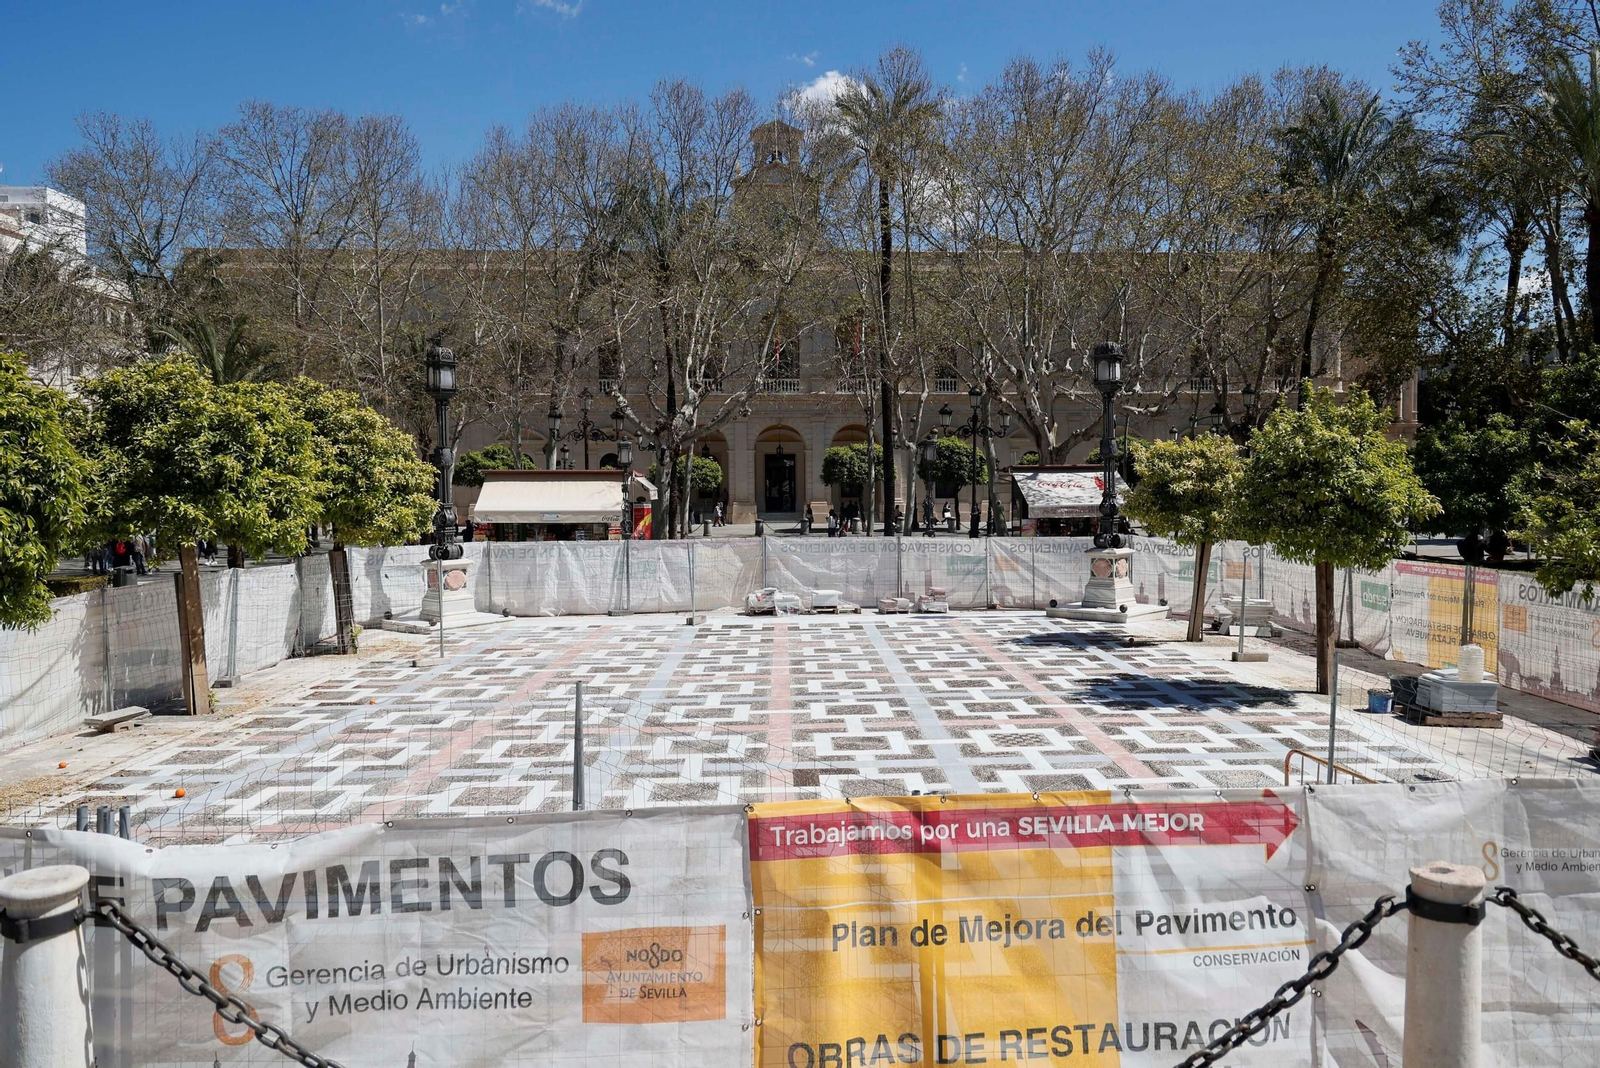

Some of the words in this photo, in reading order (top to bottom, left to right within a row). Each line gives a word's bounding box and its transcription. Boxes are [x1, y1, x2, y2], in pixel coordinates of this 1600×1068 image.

[770, 818, 913, 849] Trabajamos
[920, 823, 959, 845] por
[966, 820, 1010, 840] una
[1018, 815, 1115, 835] SEVILLA
[1122, 812, 1205, 833] MEJOR
[1500, 847, 1549, 859] Gerencia
[1551, 847, 1567, 859] de
[1515, 864, 1522, 874] y
[1525, 861, 1558, 872] Medio
[152, 848, 632, 932] PAVIMENTOS
[831, 920, 898, 952] Plan
[910, 918, 948, 948] de
[959, 914, 1066, 949] Mejora
[1075, 911, 1123, 938] del
[1135, 904, 1298, 937] Pavimento
[265, 959, 386, 988] Gerencia
[395, 956, 427, 978] de
[436, 951, 570, 977] Urbanismo
[1193, 948, 1300, 968] CONSERVACIÓN
[606, 971, 703, 985] AYUNTAMIENTO
[639, 985, 687, 1000] SEVILLA
[305, 1000, 320, 1024] y
[329, 988, 409, 1016] Medio
[416, 986, 533, 1011] Ambiente
[787, 1032, 922, 1068] OBRAS
[936, 1031, 987, 1065] DE
